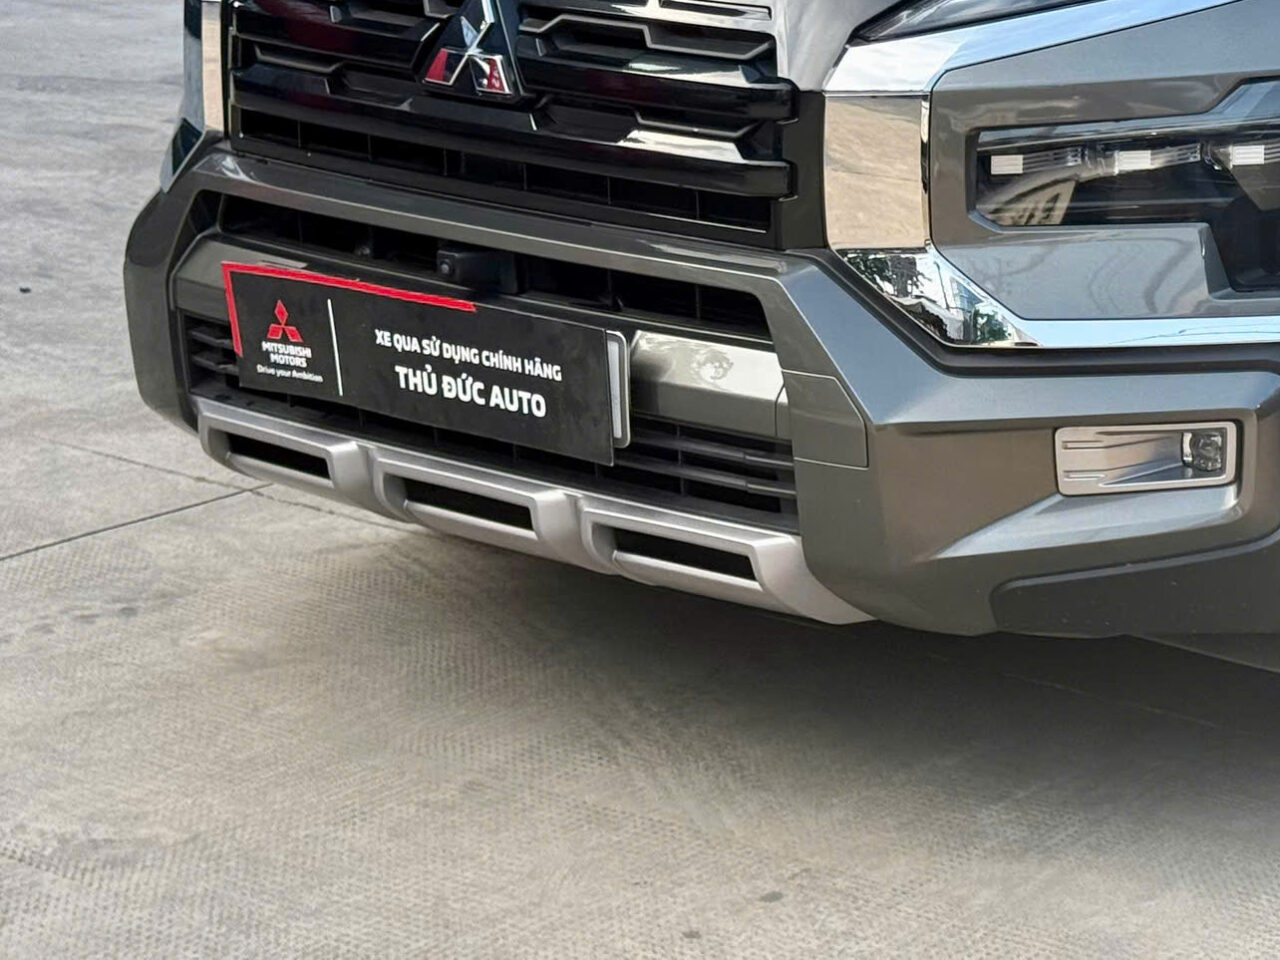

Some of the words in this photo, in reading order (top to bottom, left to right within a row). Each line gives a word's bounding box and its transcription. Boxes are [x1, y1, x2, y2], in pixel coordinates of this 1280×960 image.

[262, 341, 312, 358] MITSUBISHI
[375, 329, 392, 348] XE
[393, 333, 421, 353] QUA
[422, 336, 441, 357] SỬ
[443, 342, 480, 364] DỤNG
[481, 350, 522, 373] CHÍNH
[524, 357, 562, 382] HÃNG
[270, 353, 307, 368] MOTORS
[256, 364, 275, 375] Drive
[276, 369, 291, 378] your
[292, 369, 323, 383] Ambition
[395, 364, 437, 395] THỦ
[441, 373, 485, 405] ĐỨC
[489, 385, 547, 418] AUTO
